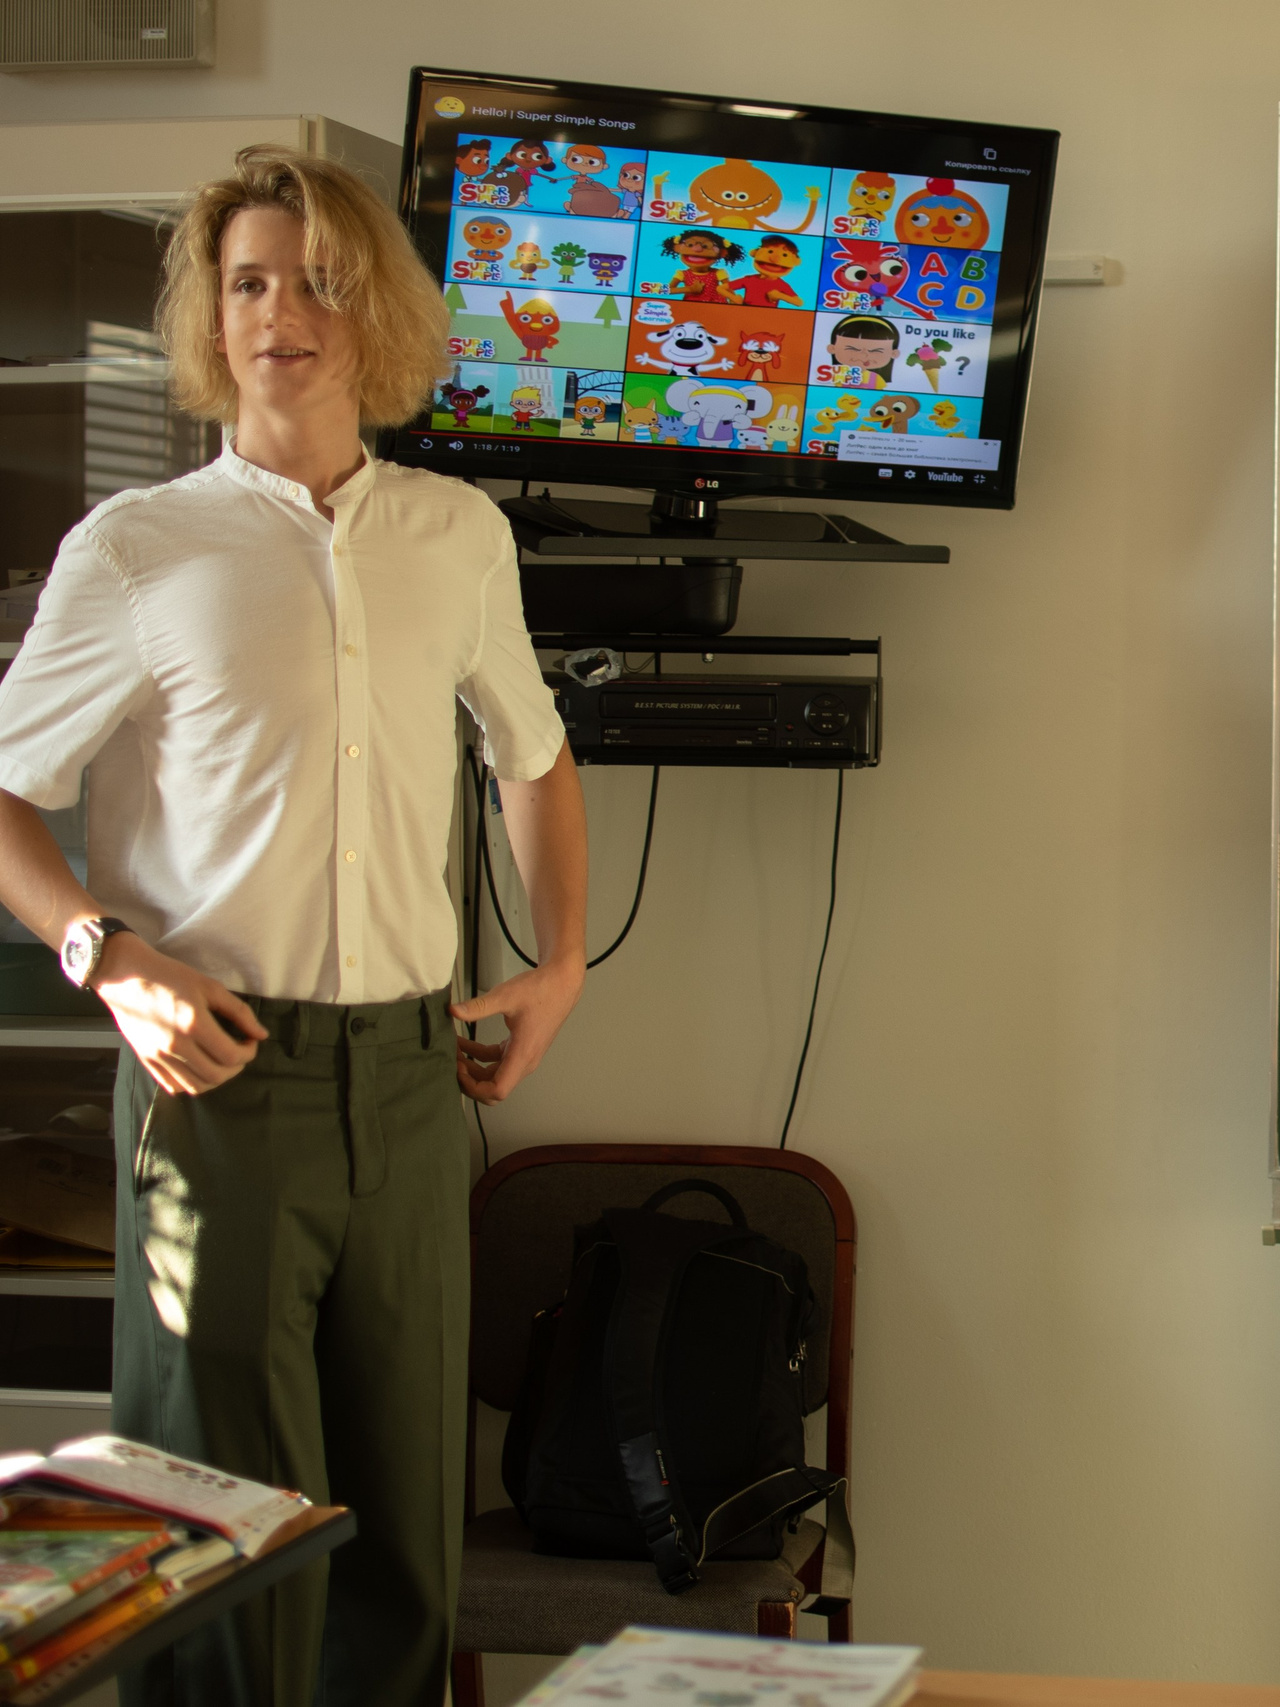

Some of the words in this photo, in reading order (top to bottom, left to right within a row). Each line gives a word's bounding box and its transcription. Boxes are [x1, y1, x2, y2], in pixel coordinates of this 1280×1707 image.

[472, 106, 507, 118] Hello!
[517, 110, 552, 124] Super
[555, 114, 595, 127] Simple
[598, 117, 636, 131] Songs
[945, 160, 997, 173] Копировать
[999, 166, 1031, 177] ссылку
[920, 253, 948, 277] A
[961, 256, 987, 281] B
[917, 283, 943, 307] C
[956, 286, 986, 310] D
[644, 309, 667, 317] Simple
[905, 325, 922, 336] Do
[926, 329, 949, 338] you
[952, 327, 975, 340] like
[955, 356, 970, 376] ?
[473, 443, 492, 451] 1:18
[502, 444, 521, 453] 1:19
[707, 480, 719, 488] LG
[927, 471, 964, 483] YouTube
